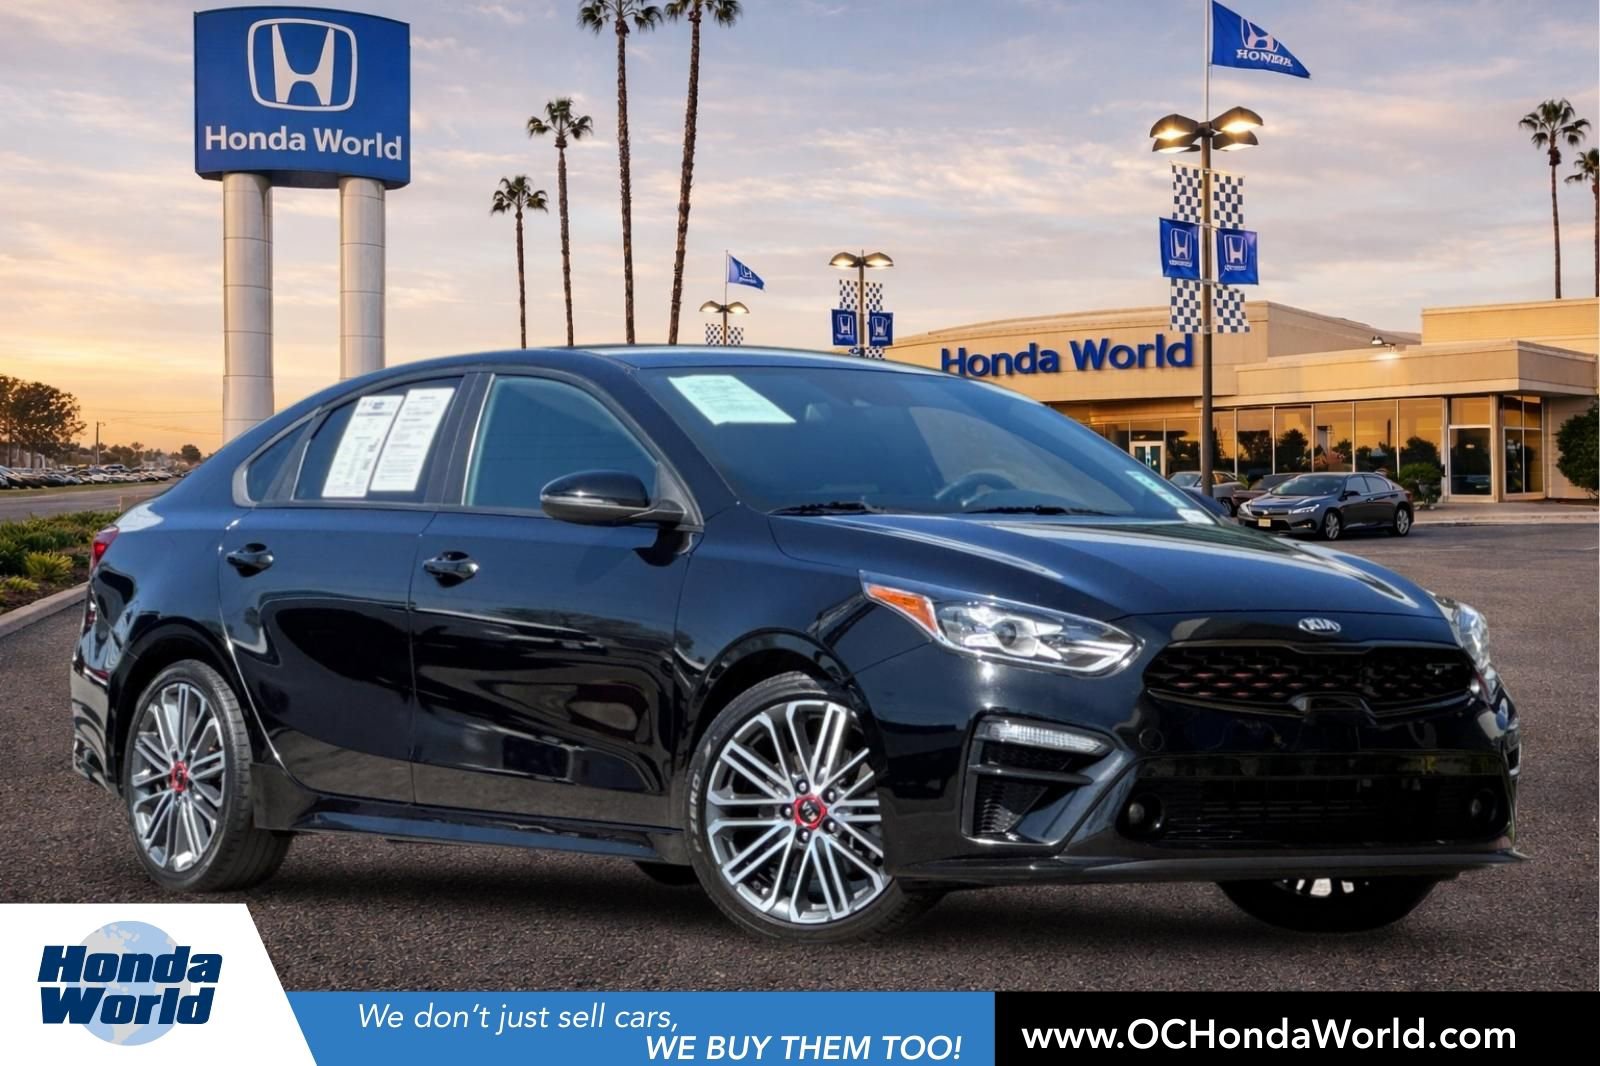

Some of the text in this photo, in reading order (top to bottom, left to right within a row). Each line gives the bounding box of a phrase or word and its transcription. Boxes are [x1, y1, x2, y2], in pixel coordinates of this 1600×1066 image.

[205, 125, 402, 160] Honda World
[941, 333, 1194, 378] Honda World
